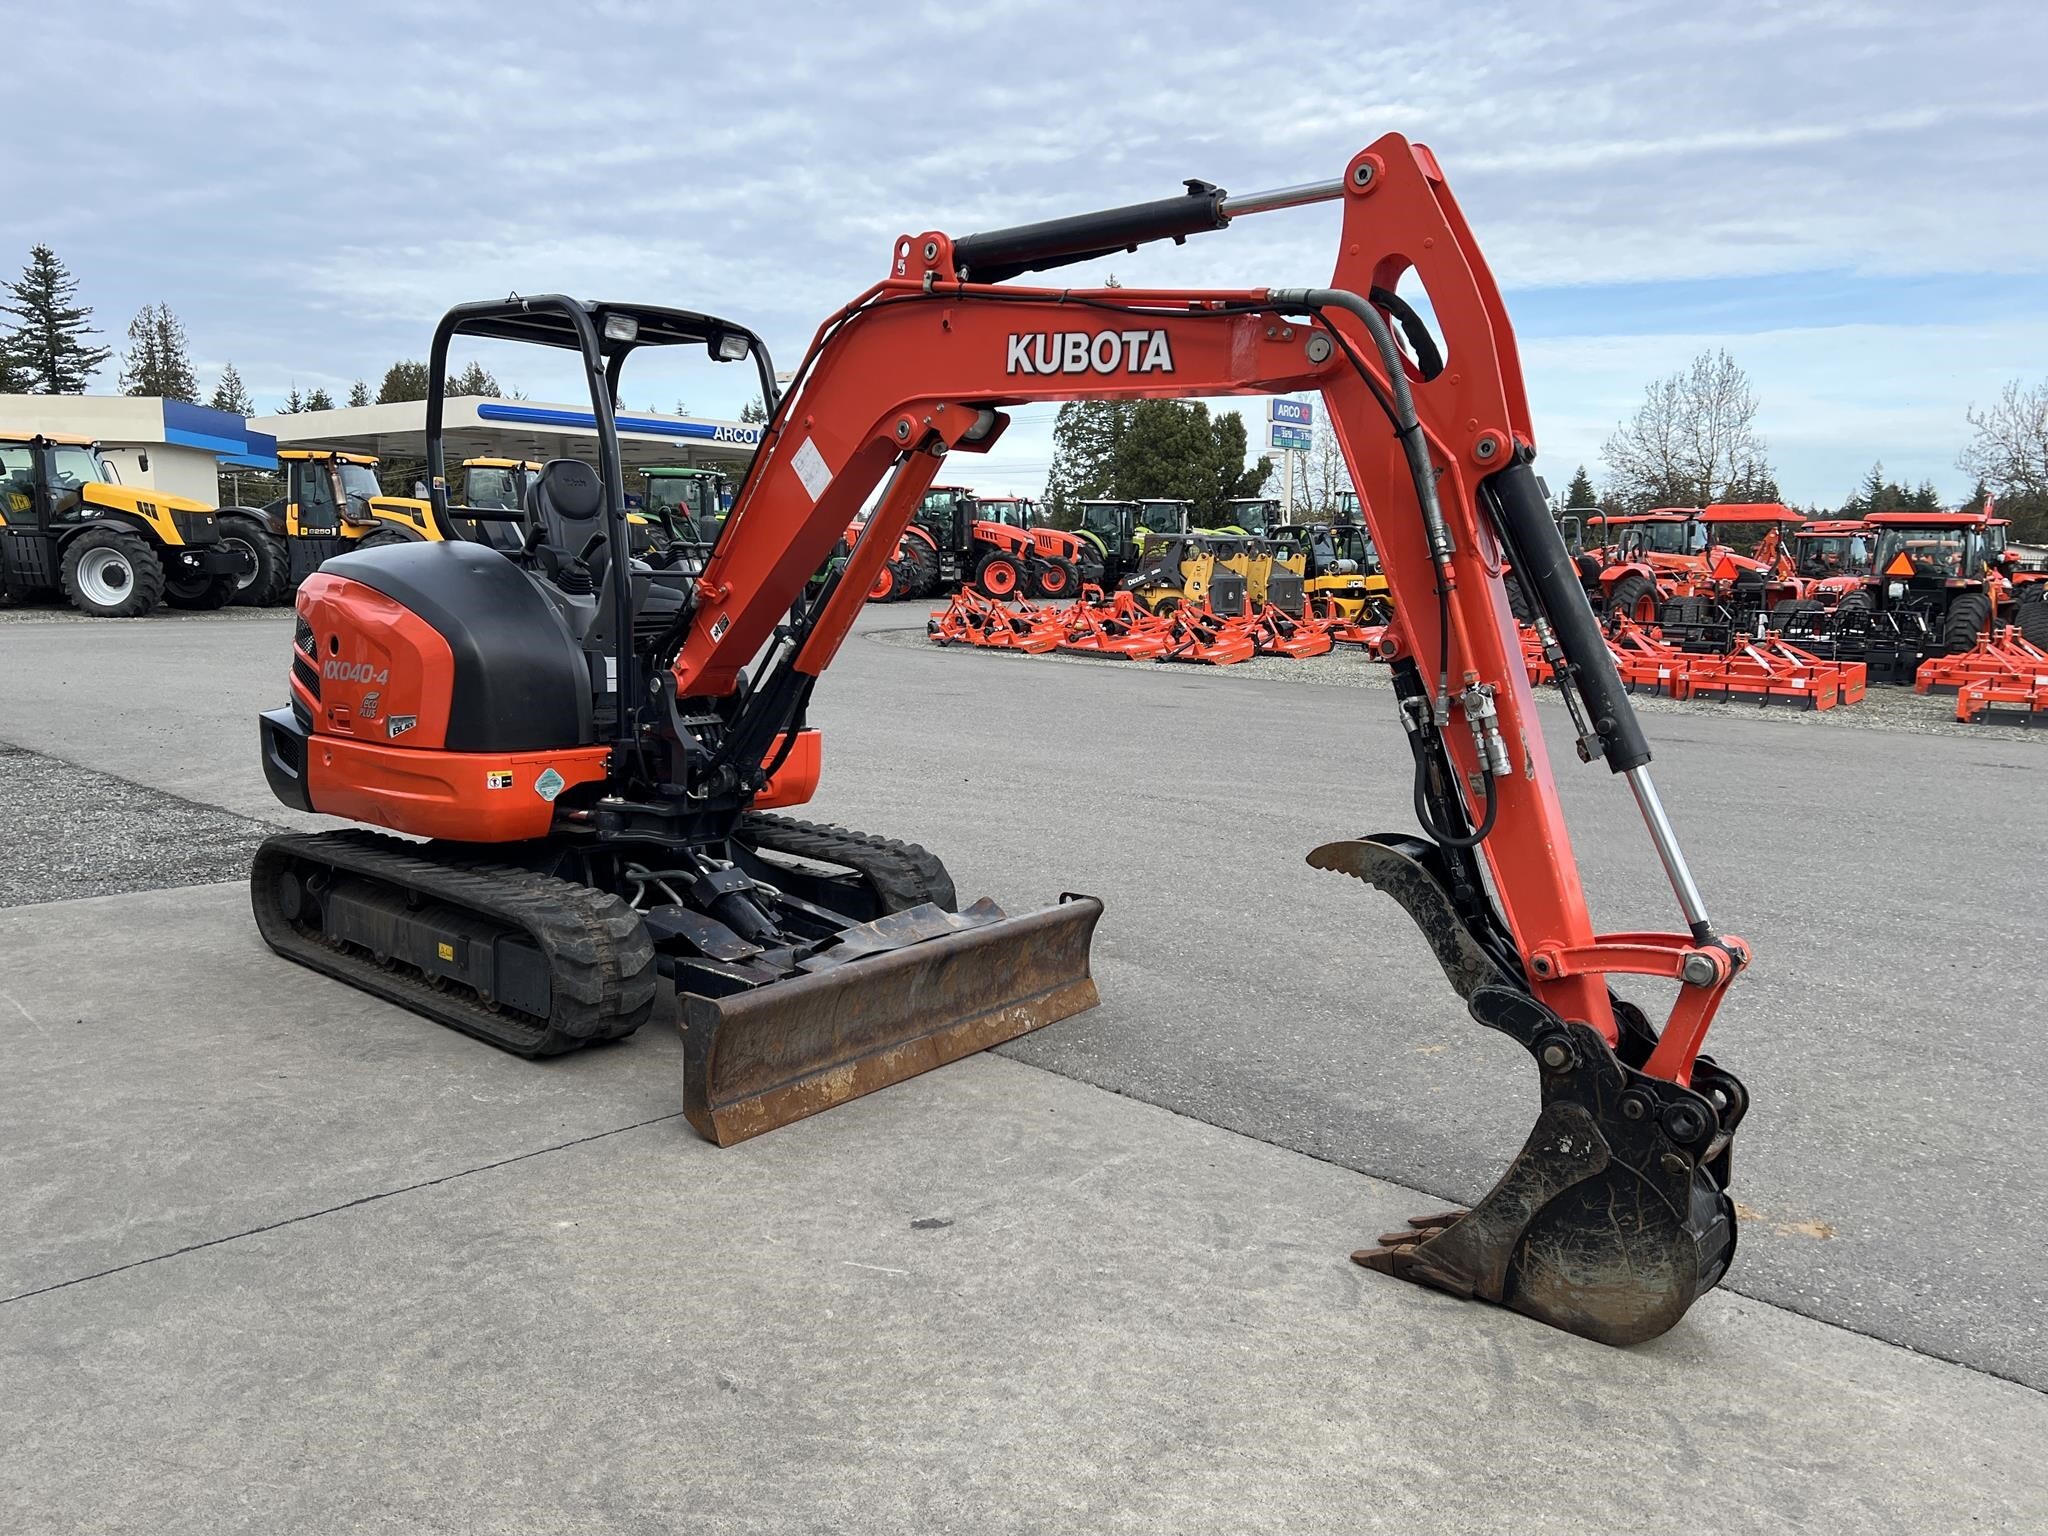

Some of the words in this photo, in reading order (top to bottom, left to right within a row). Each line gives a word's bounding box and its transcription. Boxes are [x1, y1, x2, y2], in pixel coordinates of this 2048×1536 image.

[1006, 330, 1174, 375] KUBOTA
[1277, 404, 1300, 418] ARCO
[713, 427, 755, 444] ARCO
[10, 493, 31, 511] JCB
[1347, 580, 1364, 588] JCB
[323, 660, 389, 686] KX040-4
[360, 709, 377, 719] PLUS
